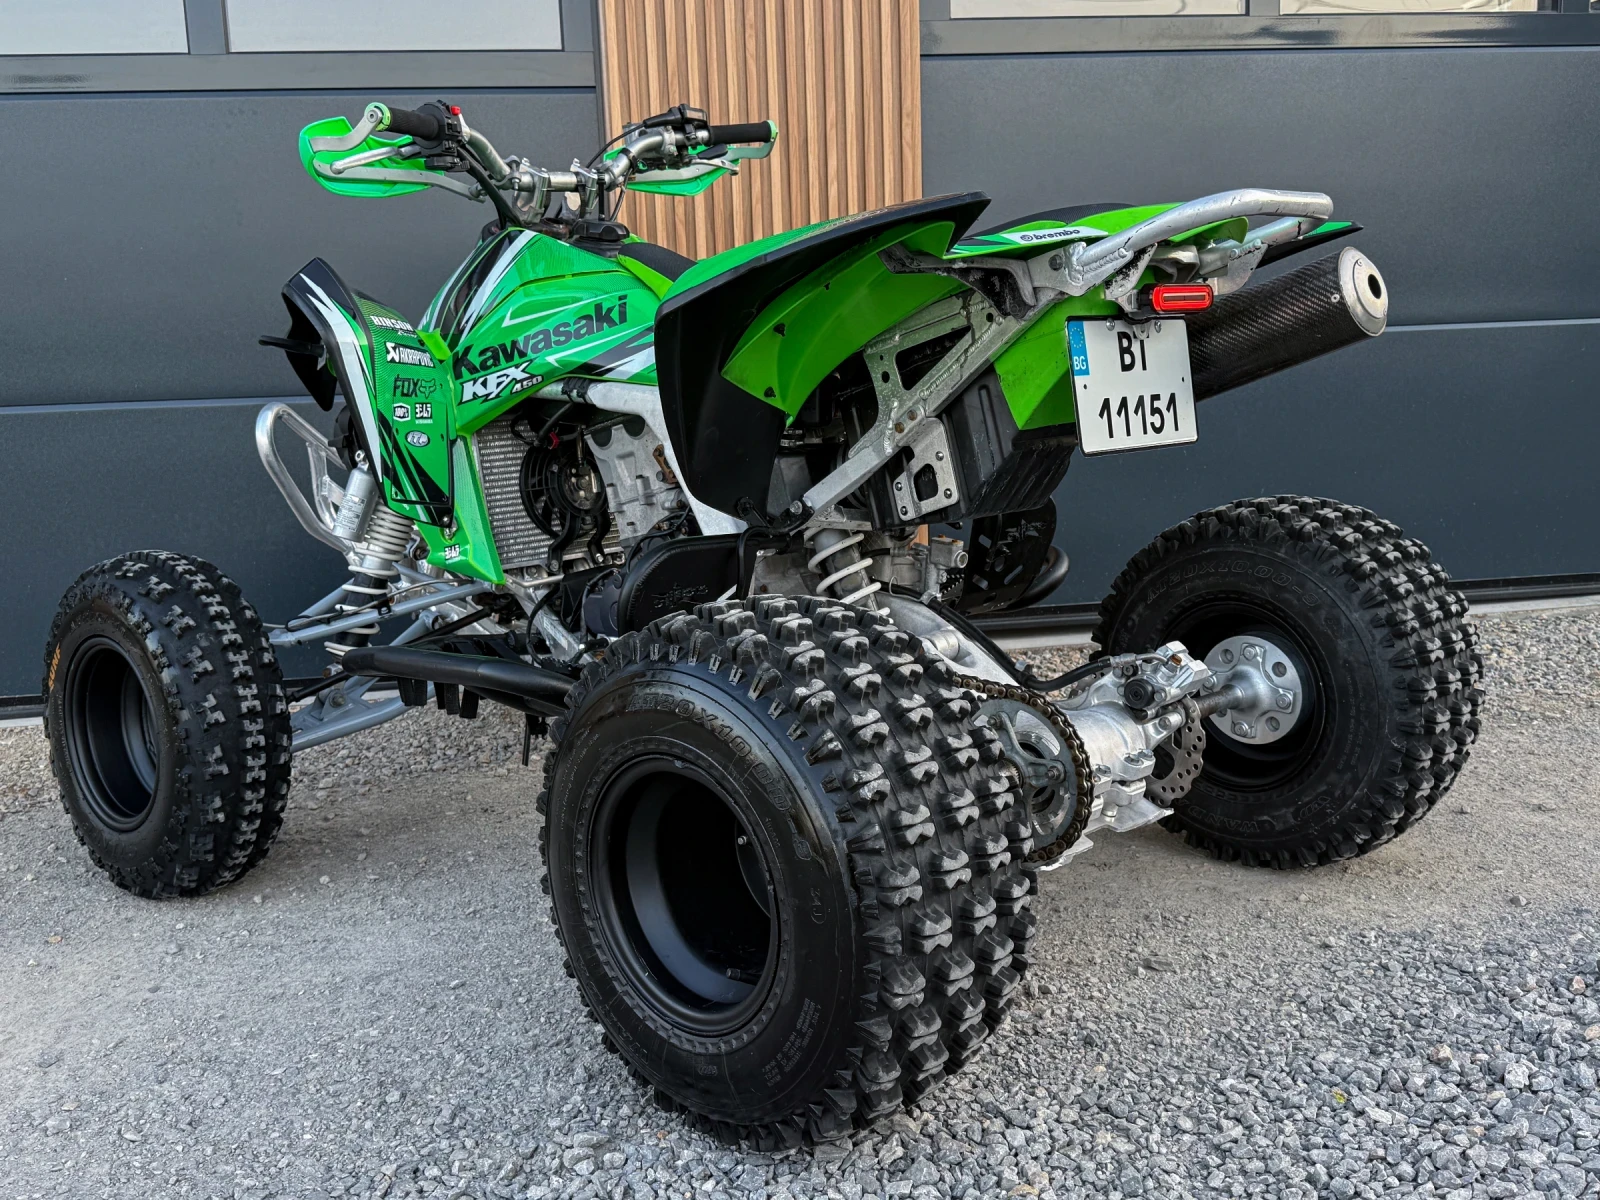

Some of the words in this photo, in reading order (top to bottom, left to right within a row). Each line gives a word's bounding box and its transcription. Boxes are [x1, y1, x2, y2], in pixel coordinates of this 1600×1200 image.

[1033, 229, 1080, 240] brembo
[452, 295, 628, 380] Kawasaki
[1073, 356, 1087, 370] BG
[393, 374, 420, 398] FOX
[460, 360, 533, 402] KFX
[511, 374, 544, 394] 450
[1098, 392, 1179, 439] 11151
